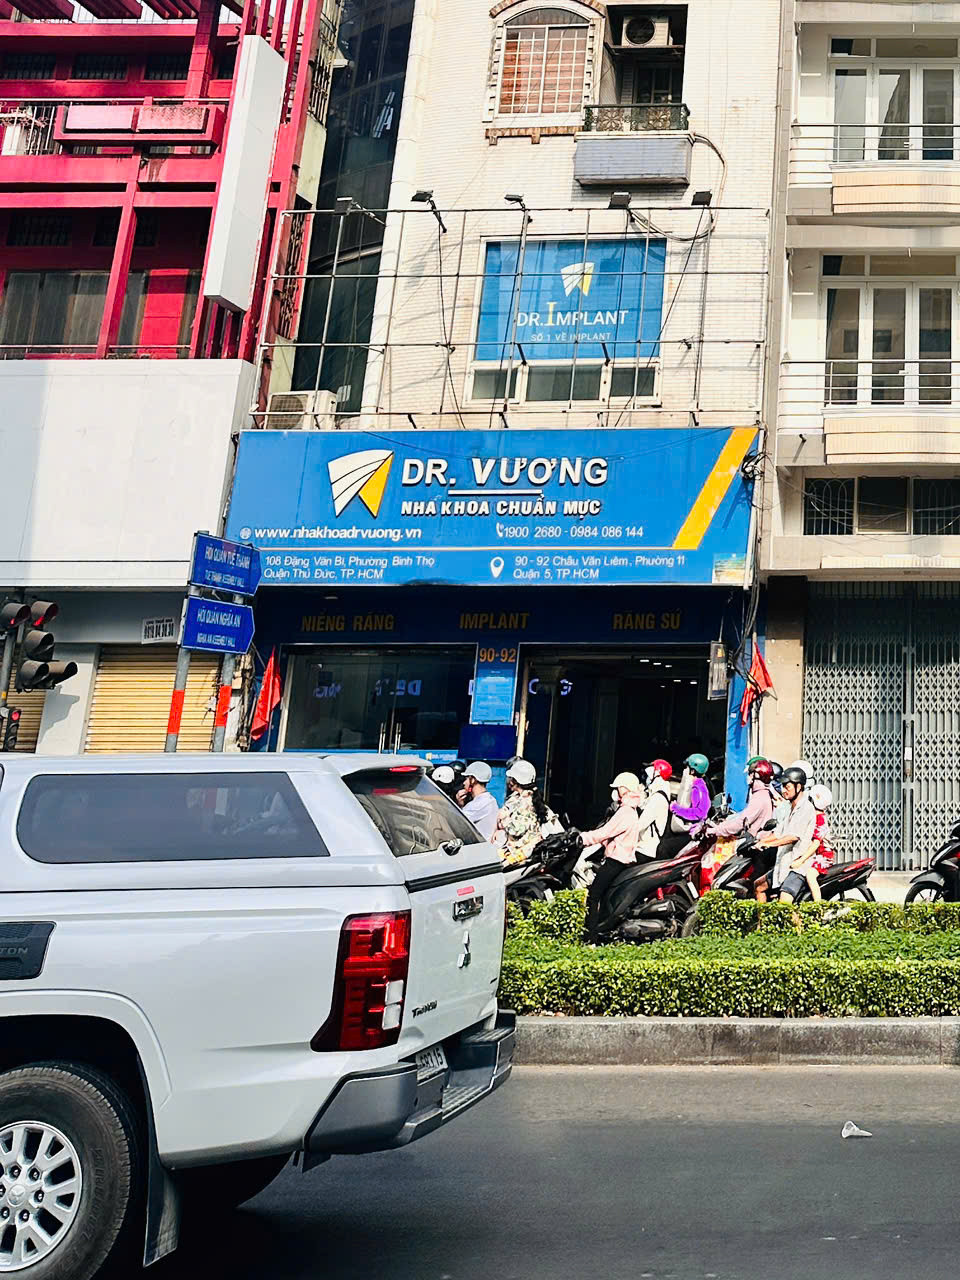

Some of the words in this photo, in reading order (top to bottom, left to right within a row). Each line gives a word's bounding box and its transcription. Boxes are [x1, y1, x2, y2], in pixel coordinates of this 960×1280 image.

[401, 458, 457, 486] DR.
[472, 457, 609, 486] VƯƠNG
[441, 500, 490, 516] KHOA
[496, 493, 557, 516] CHUẨN
[563, 498, 601, 521] MỰC
[254, 526, 422, 542] www.nhakhoadrvuong.vn
[504, 526, 529, 538] 1900
[534, 526, 562, 538] 2680
[570, 526, 598, 538] 0984
[601, 526, 622, 538] 086
[625, 526, 644, 537] 144
[265, 556, 282, 566] 108
[313, 556, 333, 566] Văn
[515, 557, 528, 567] 90
[536, 557, 550, 567] 92
[552, 556, 579, 567] Châu
[582, 556, 601, 567] Văn
[677, 555, 686, 565] 11
[458, 612, 530, 630] IMPLANT
